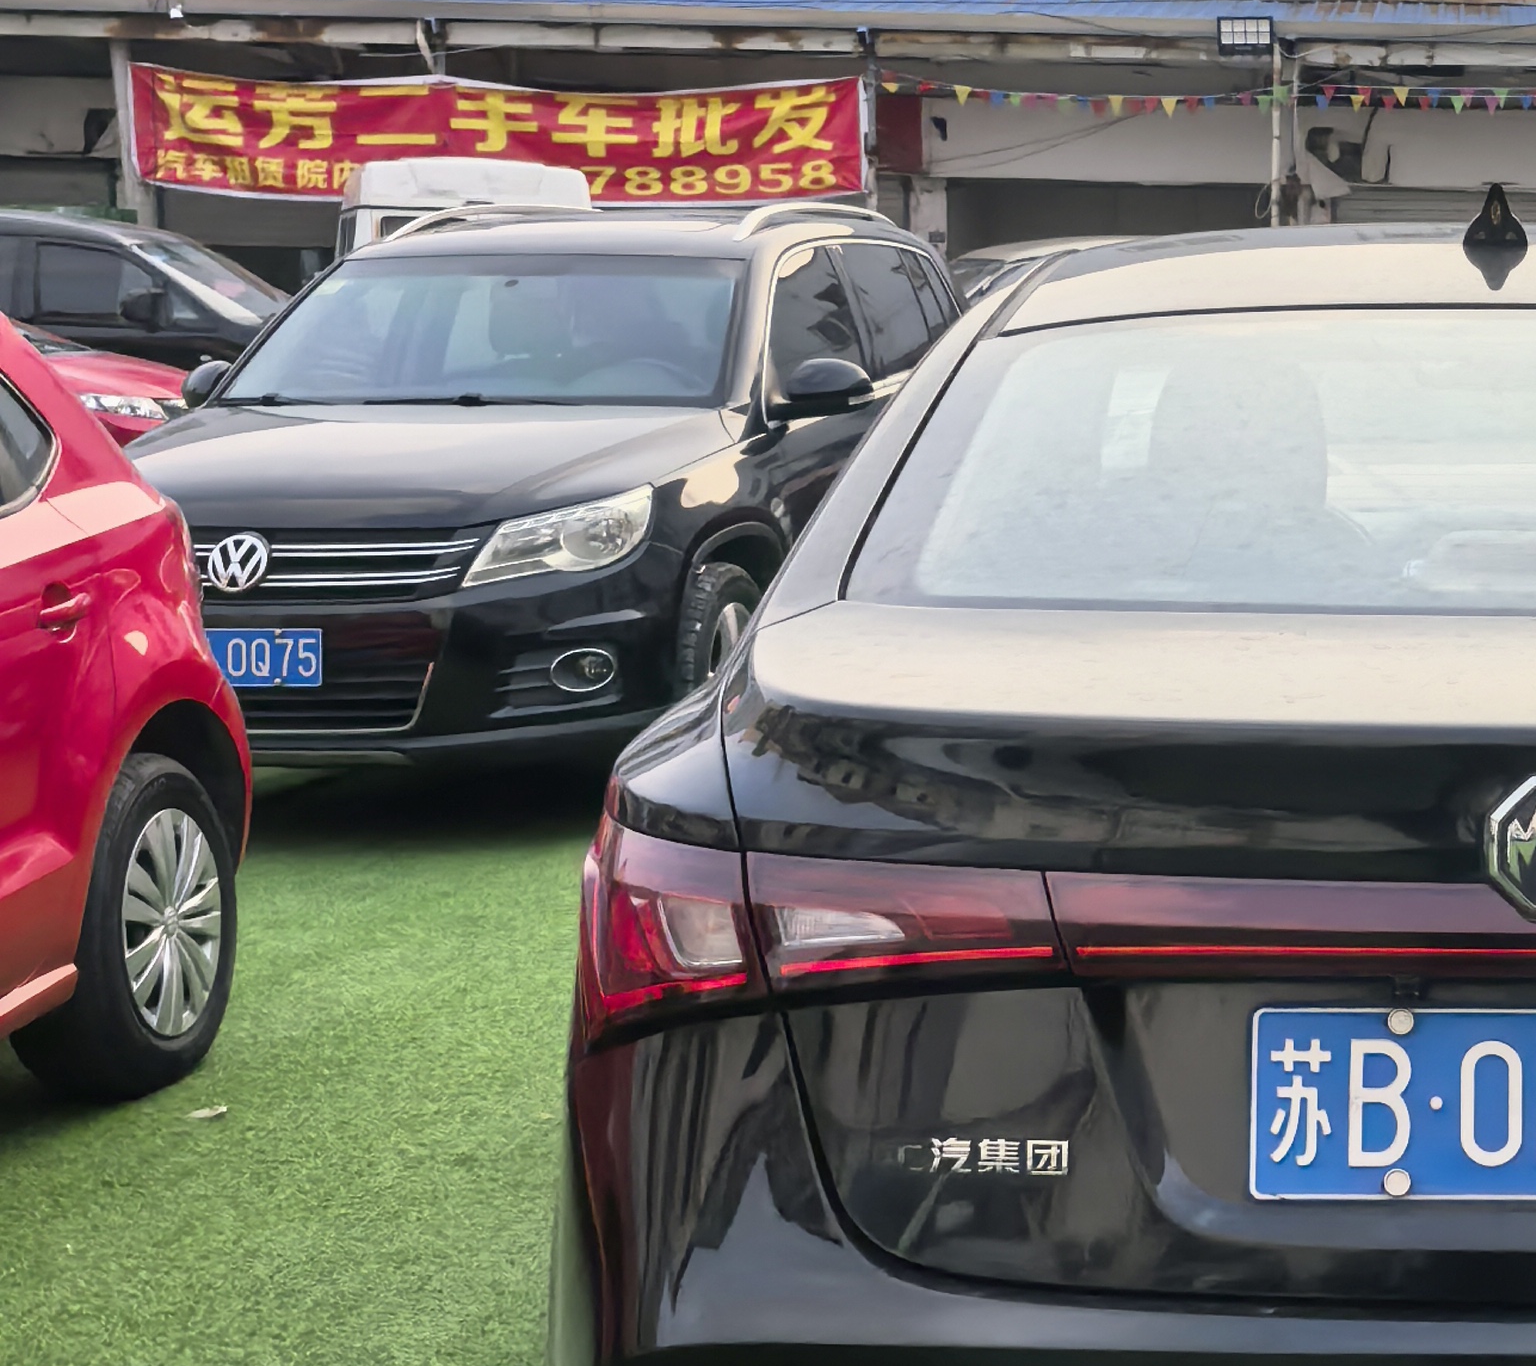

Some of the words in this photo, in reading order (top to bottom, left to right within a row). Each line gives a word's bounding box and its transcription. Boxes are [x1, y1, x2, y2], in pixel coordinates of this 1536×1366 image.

[155, 73, 838, 157] 运芳二手车批发
